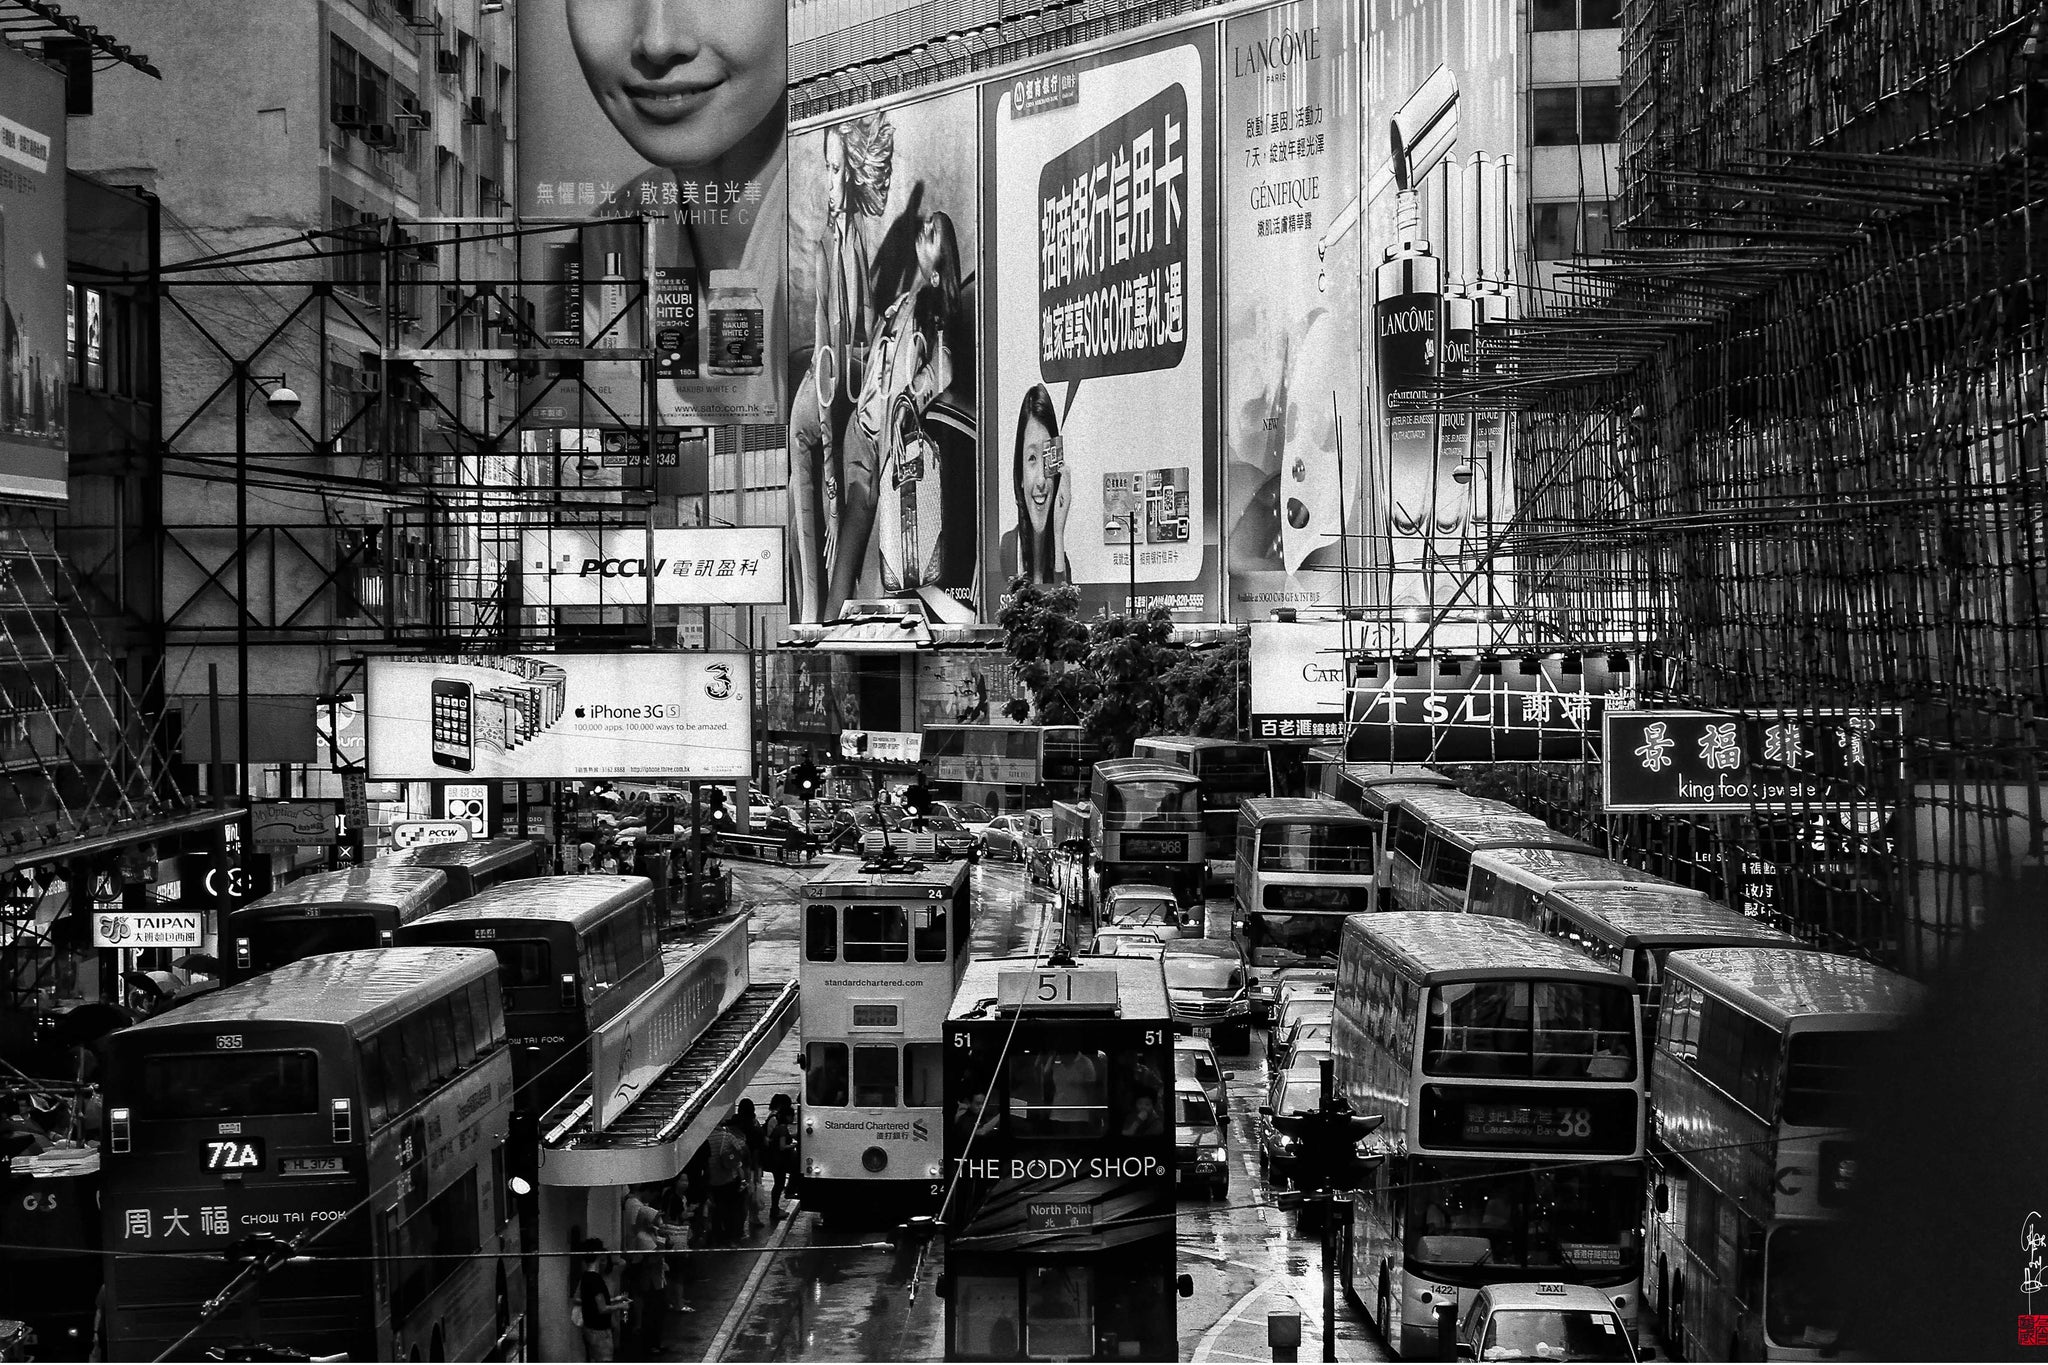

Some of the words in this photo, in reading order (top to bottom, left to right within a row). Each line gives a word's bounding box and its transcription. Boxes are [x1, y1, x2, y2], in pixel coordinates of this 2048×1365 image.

[1235, 27, 1320, 78] LANCÔME
[1266, 72, 1286, 84] PARIS
[1250, 176, 1320, 210] GÉNIFIQUE
[1042, 114, 1183, 292] 招商银行信用卡
[674, 209, 729, 225] WHITE
[738, 209, 749, 225] C
[655, 293, 692, 305] AKUBI
[655, 307, 683, 318] HITE
[685, 307, 694, 318] C
[570, 312, 580, 329] GEL
[1381, 306, 1434, 337] LANCÔME
[674, 404, 759, 413] www.sato.com.hk
[1263, 418, 1279, 431] NEW
[579, 558, 667, 577] PCCW
[672, 559, 759, 577] 電訊盈科
[955, 587, 971, 599] SOGO
[705, 662, 737, 700] 3
[590, 704, 641, 718] iPhone
[1378, 694, 1492, 724] TSL
[697, 723, 729, 731] amazed.
[1679, 773, 1714, 802] king
[429, 829, 457, 837] PCCW
[1161, 841, 1182, 853] 968
[810, 888, 823, 897] 24
[928, 889, 942, 899] 24
[134, 918, 195, 928] TAIPAN
[825, 979, 923, 987] standardchartered.com
[1037, 974, 1072, 1001] 51
[216, 1035, 242, 1048] 635
[524, 1036, 538, 1044] TAI
[541, 1035, 565, 1043] FOOK
[954, 1032, 971, 1047] 51
[1145, 1030, 1163, 1045] 51
[825, 1121, 864, 1129] Standard
[866, 1121, 910, 1130] Chartered
[1557, 1108, 1591, 1136] 38
[1465, 1125, 1480, 1133] via
[1483, 1124, 1533, 1136] Causeway
[207, 1142, 258, 1168] 72A
[954, 1158, 1000, 1179] THE
[1012, 1158, 1083, 1179] BODY
[1031, 1204, 1061, 1215] North
[1065, 1204, 1092, 1214] Point
[125, 1206, 230, 1239] 周大福
[241, 1213, 279, 1224] CHOW
[283, 1212, 305, 1223] TAI
[310, 1210, 347, 1221] FOOK
[1430, 1286, 1453, 1294] 1422
[1540, 1284, 1564, 1292] TAXI
